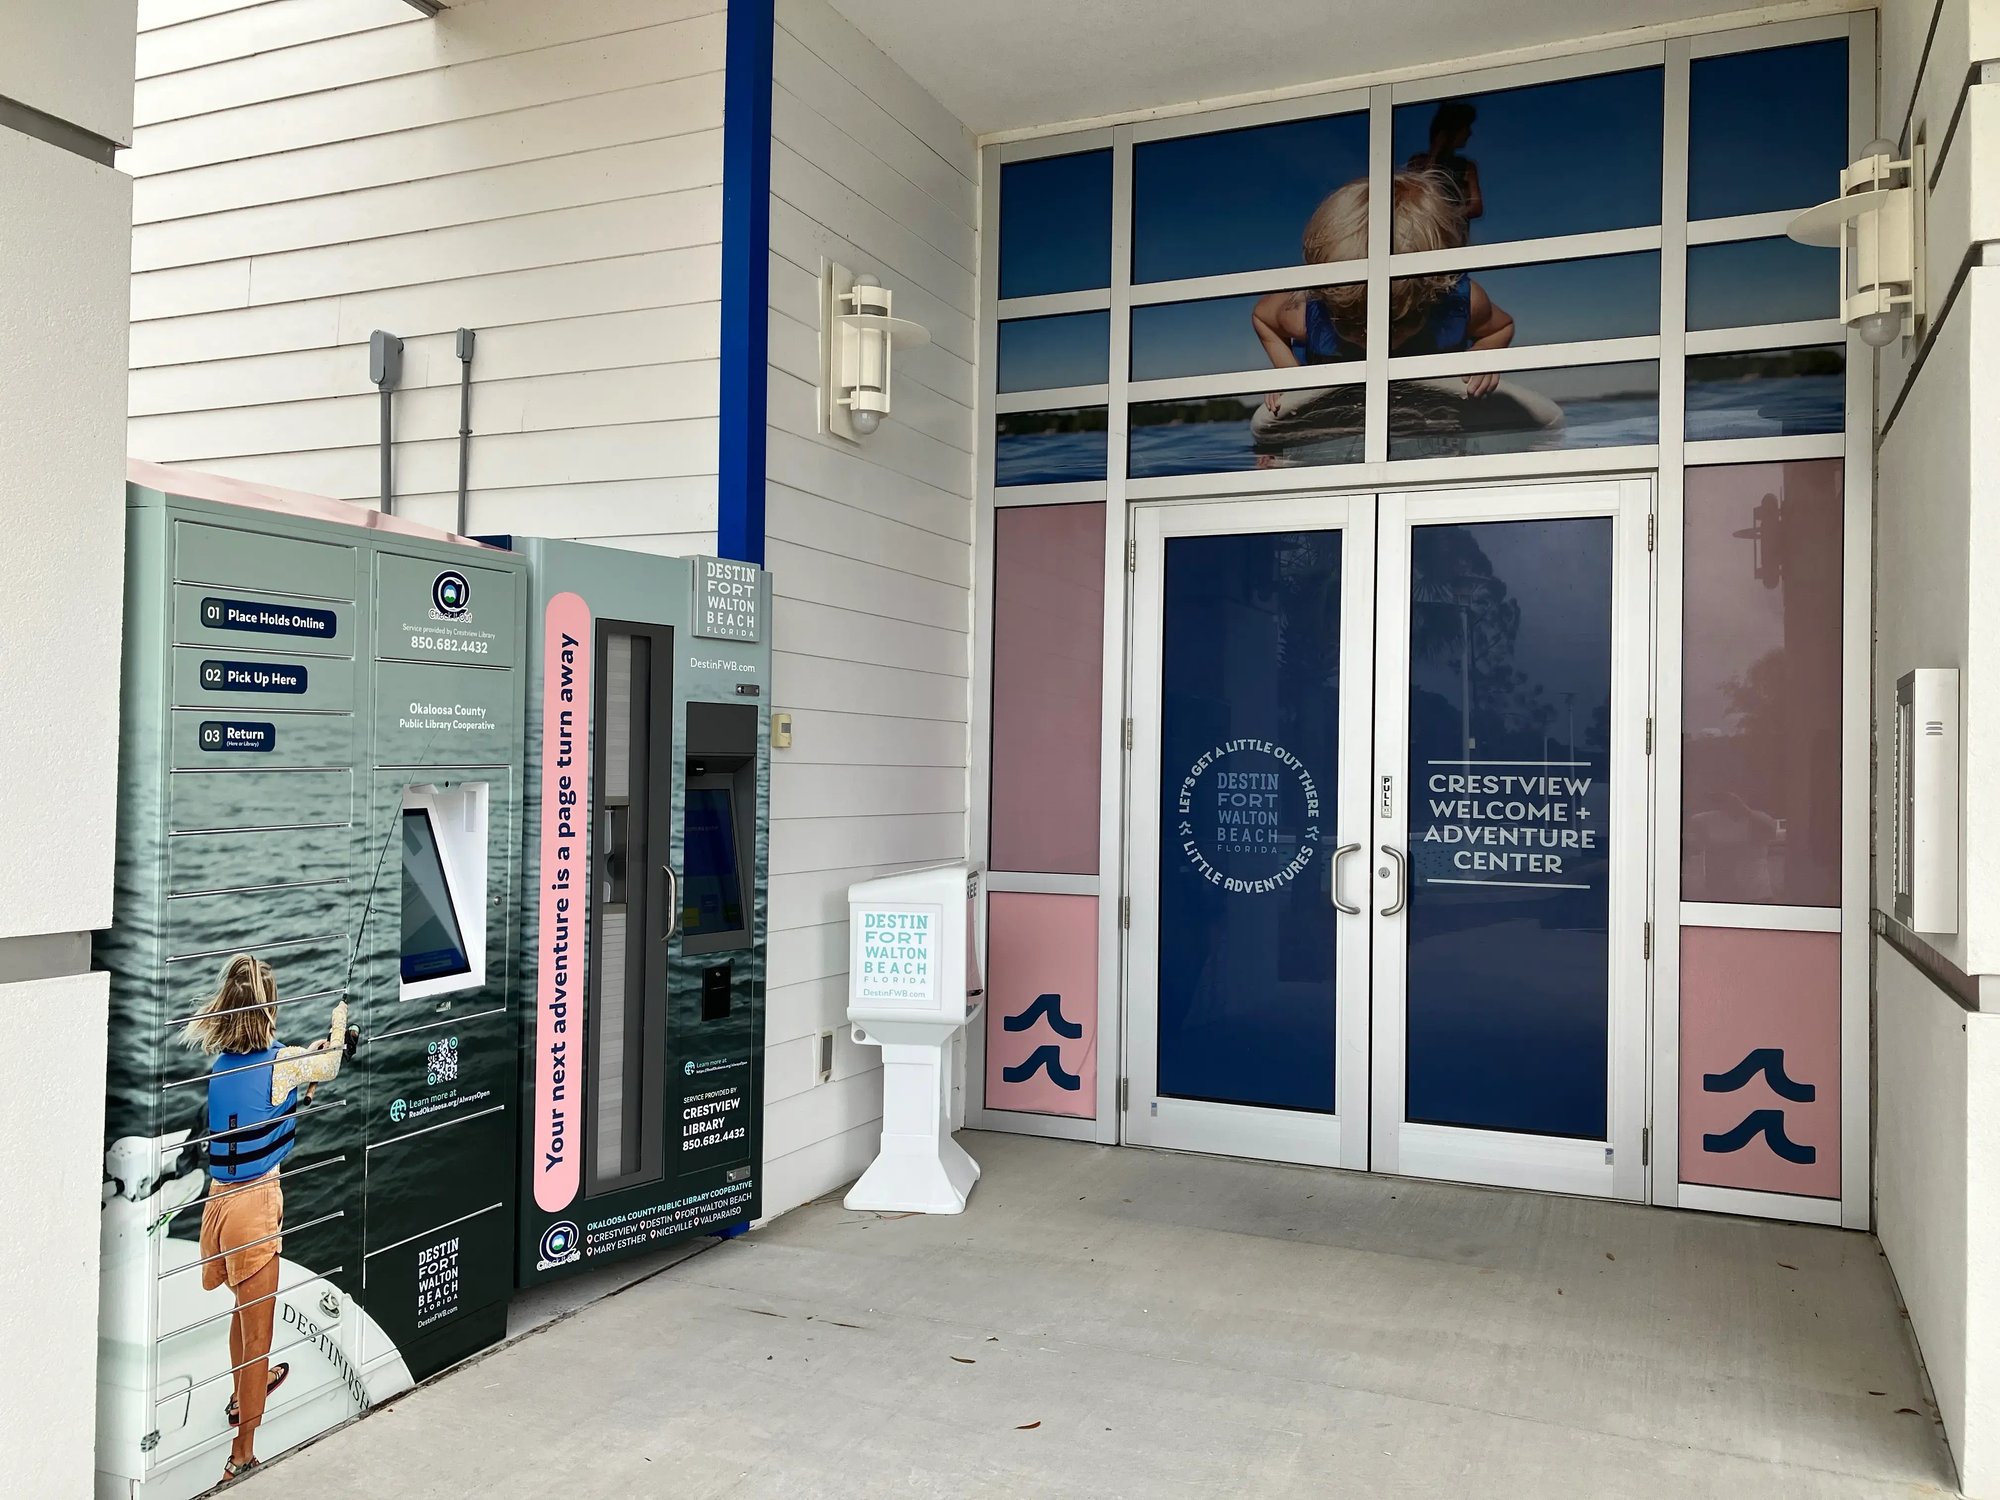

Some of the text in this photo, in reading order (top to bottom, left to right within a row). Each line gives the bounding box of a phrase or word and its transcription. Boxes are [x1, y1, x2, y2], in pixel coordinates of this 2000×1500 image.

[707, 562, 755, 583] DESTIN
[707, 580, 754, 598] FORT
[708, 595, 754, 613] WALTON
[207, 606, 325, 630] 01 Place Holds Online
[707, 611, 754, 628] BEACH
[402, 623, 495, 640] Service provided by Crestview Library
[707, 626, 754, 637] FLORIDA
[411, 636, 488, 654] 850.682.4432
[690, 657, 756, 673] DestinFWB.com
[205, 668, 297, 687] 02 Pick Up Here
[410, 702, 486, 719] Okaloosa County
[400, 719, 495, 731] Public Library Cooperative
[204, 727, 264, 743] 03 Return
[1179, 739, 1319, 818] LET'S GET A LITTLE OUT THERE
[1217, 772, 1279, 790] DESTIN
[1428, 774, 1592, 796] CRESTVIEW
[1217, 793, 1278, 808] FORT
[1218, 810, 1278, 826] WALTON
[1429, 800, 1568, 822] WELCOME
[1217, 828, 1278, 843] BEACH
[1423, 825, 1596, 849] ADVENTURE
[1217, 845, 1277, 854] FLORIDA
[1224, 845, 1313, 894] ADVENTURES
[1453, 851, 1563, 873] CENTER
[967, 882, 977, 899] REE
[545, 632, 579, 1173] Your next adventure is a page turn away
[865, 913, 928, 929] DESTIN
[865, 931, 927, 944] FORT
[865, 946, 927, 960] WALTON
[864, 961, 927, 975] BEACH
[864, 976, 926, 984] FLORIDA
[863, 988, 926, 998] DestinFWB.com
[409, 1089, 457, 1109] Learn more at
[409, 1090, 490, 1118] ReadOkaloosa.org/AlwaysOpen
[683, 1094, 704, 1104] SERVICE
[705, 1088, 729, 1099] PROVIDED
[683, 1097, 740, 1120] CRESTVIEW
[683, 1117, 725, 1136] LIBRARY
[682, 1127, 745, 1151] 850.682.4432
[587, 1180, 753, 1231] OKALOOSA COUNTY PUBLIC LIBRARY COOPERATIVE
[594, 1192, 752, 1243] CRESTVIEW DESTIN FORT WALTON BEACH
[594, 1206, 742, 1256] MARY ESTHER NICEVILLE VALPARAISO
[419, 1237, 459, 1266] DESTIN
[419, 1253, 458, 1280] FORT
[419, 1266, 458, 1293] WALTON
[418, 1280, 458, 1307] BEACH
[418, 1293, 458, 1315] FLORIDA
[417, 1306, 458, 1328] DestinFWB.com
